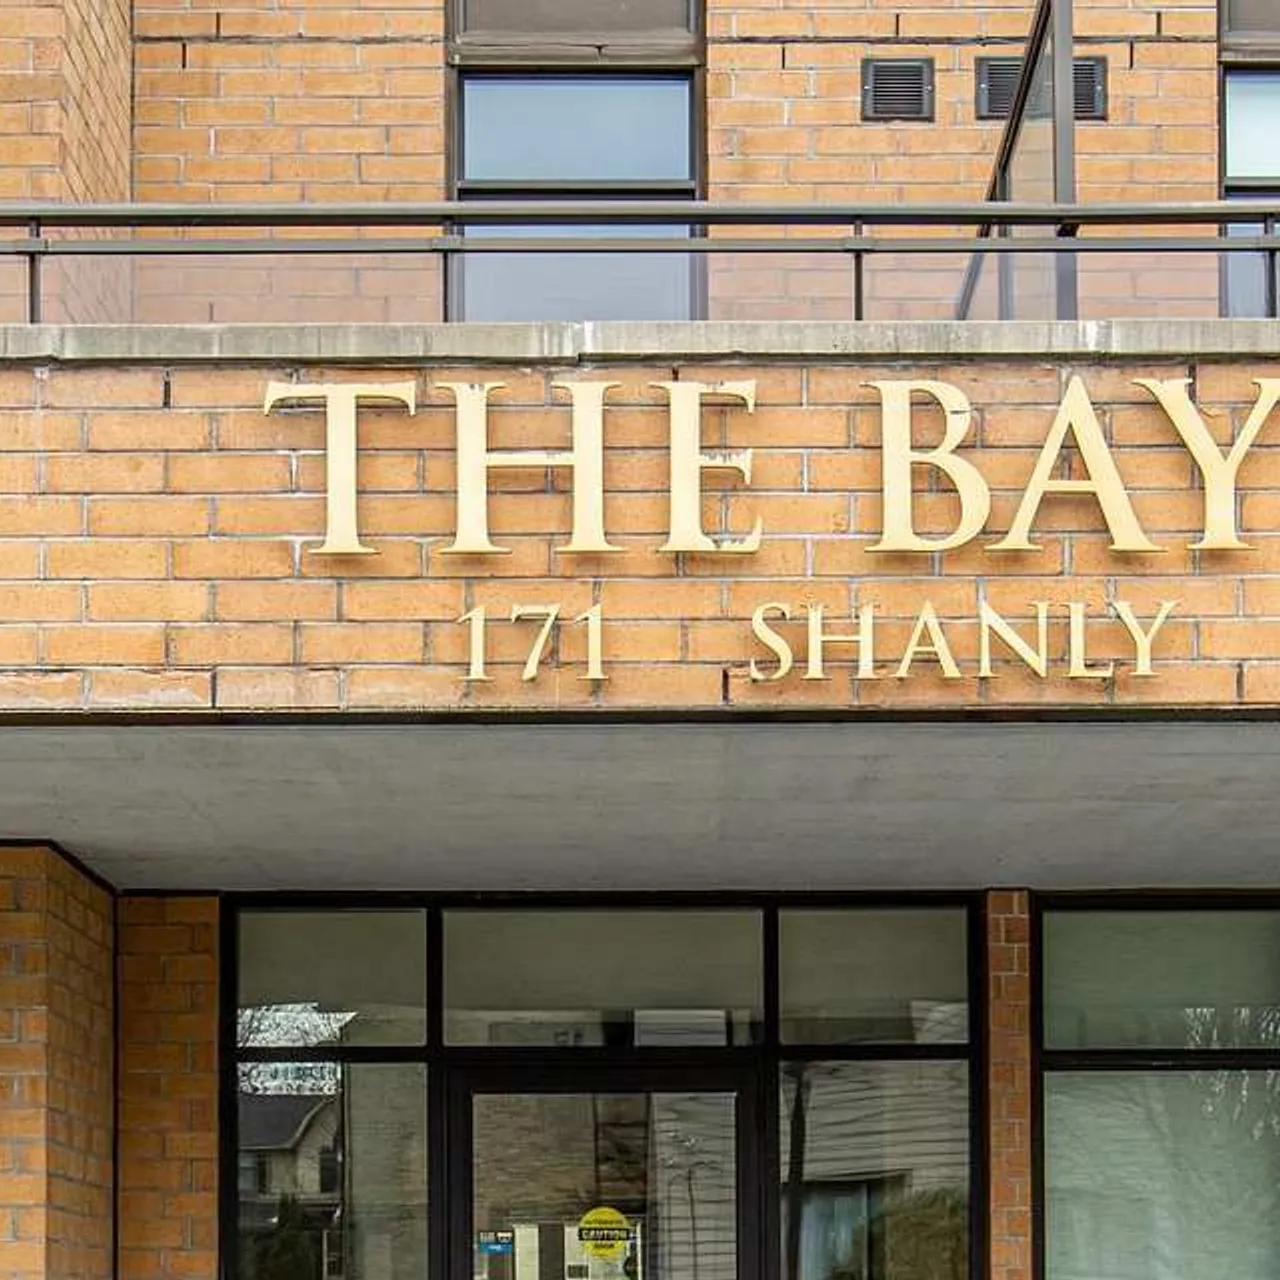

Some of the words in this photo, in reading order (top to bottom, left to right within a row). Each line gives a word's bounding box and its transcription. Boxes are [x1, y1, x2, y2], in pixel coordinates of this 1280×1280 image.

[264, 380, 763, 554] THE
[457, 602, 609, 681] 171
[749, 600, 1177, 681] SHANLY
